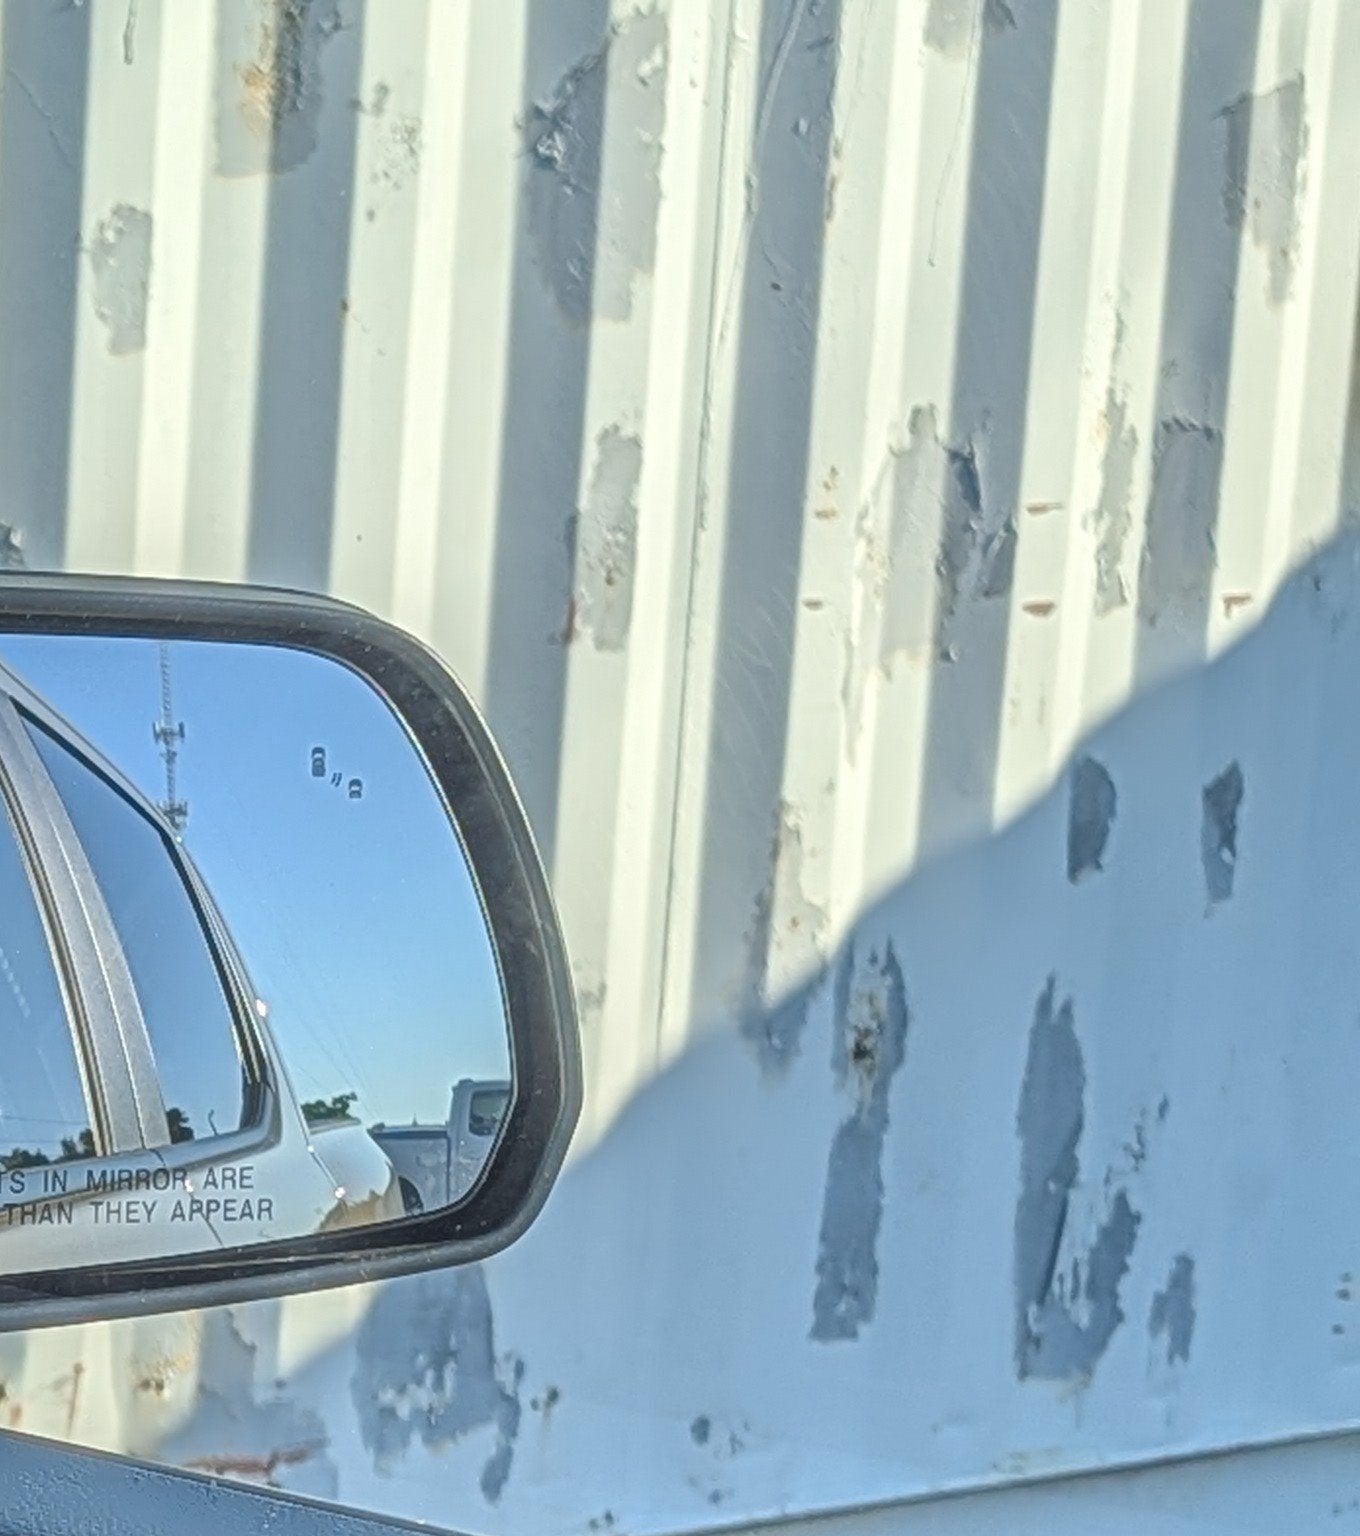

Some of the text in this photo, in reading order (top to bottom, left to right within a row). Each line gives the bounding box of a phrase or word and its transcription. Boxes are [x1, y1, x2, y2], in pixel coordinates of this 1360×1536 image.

[43, 1169, 68, 1193] IN
[86, 1168, 188, 1192] MIRROR
[203, 1166, 254, 1190] ARE
[3, 1202, 73, 1226] THAN
[90, 1201, 157, 1224] THEY
[170, 1199, 274, 1222] APPEAR
